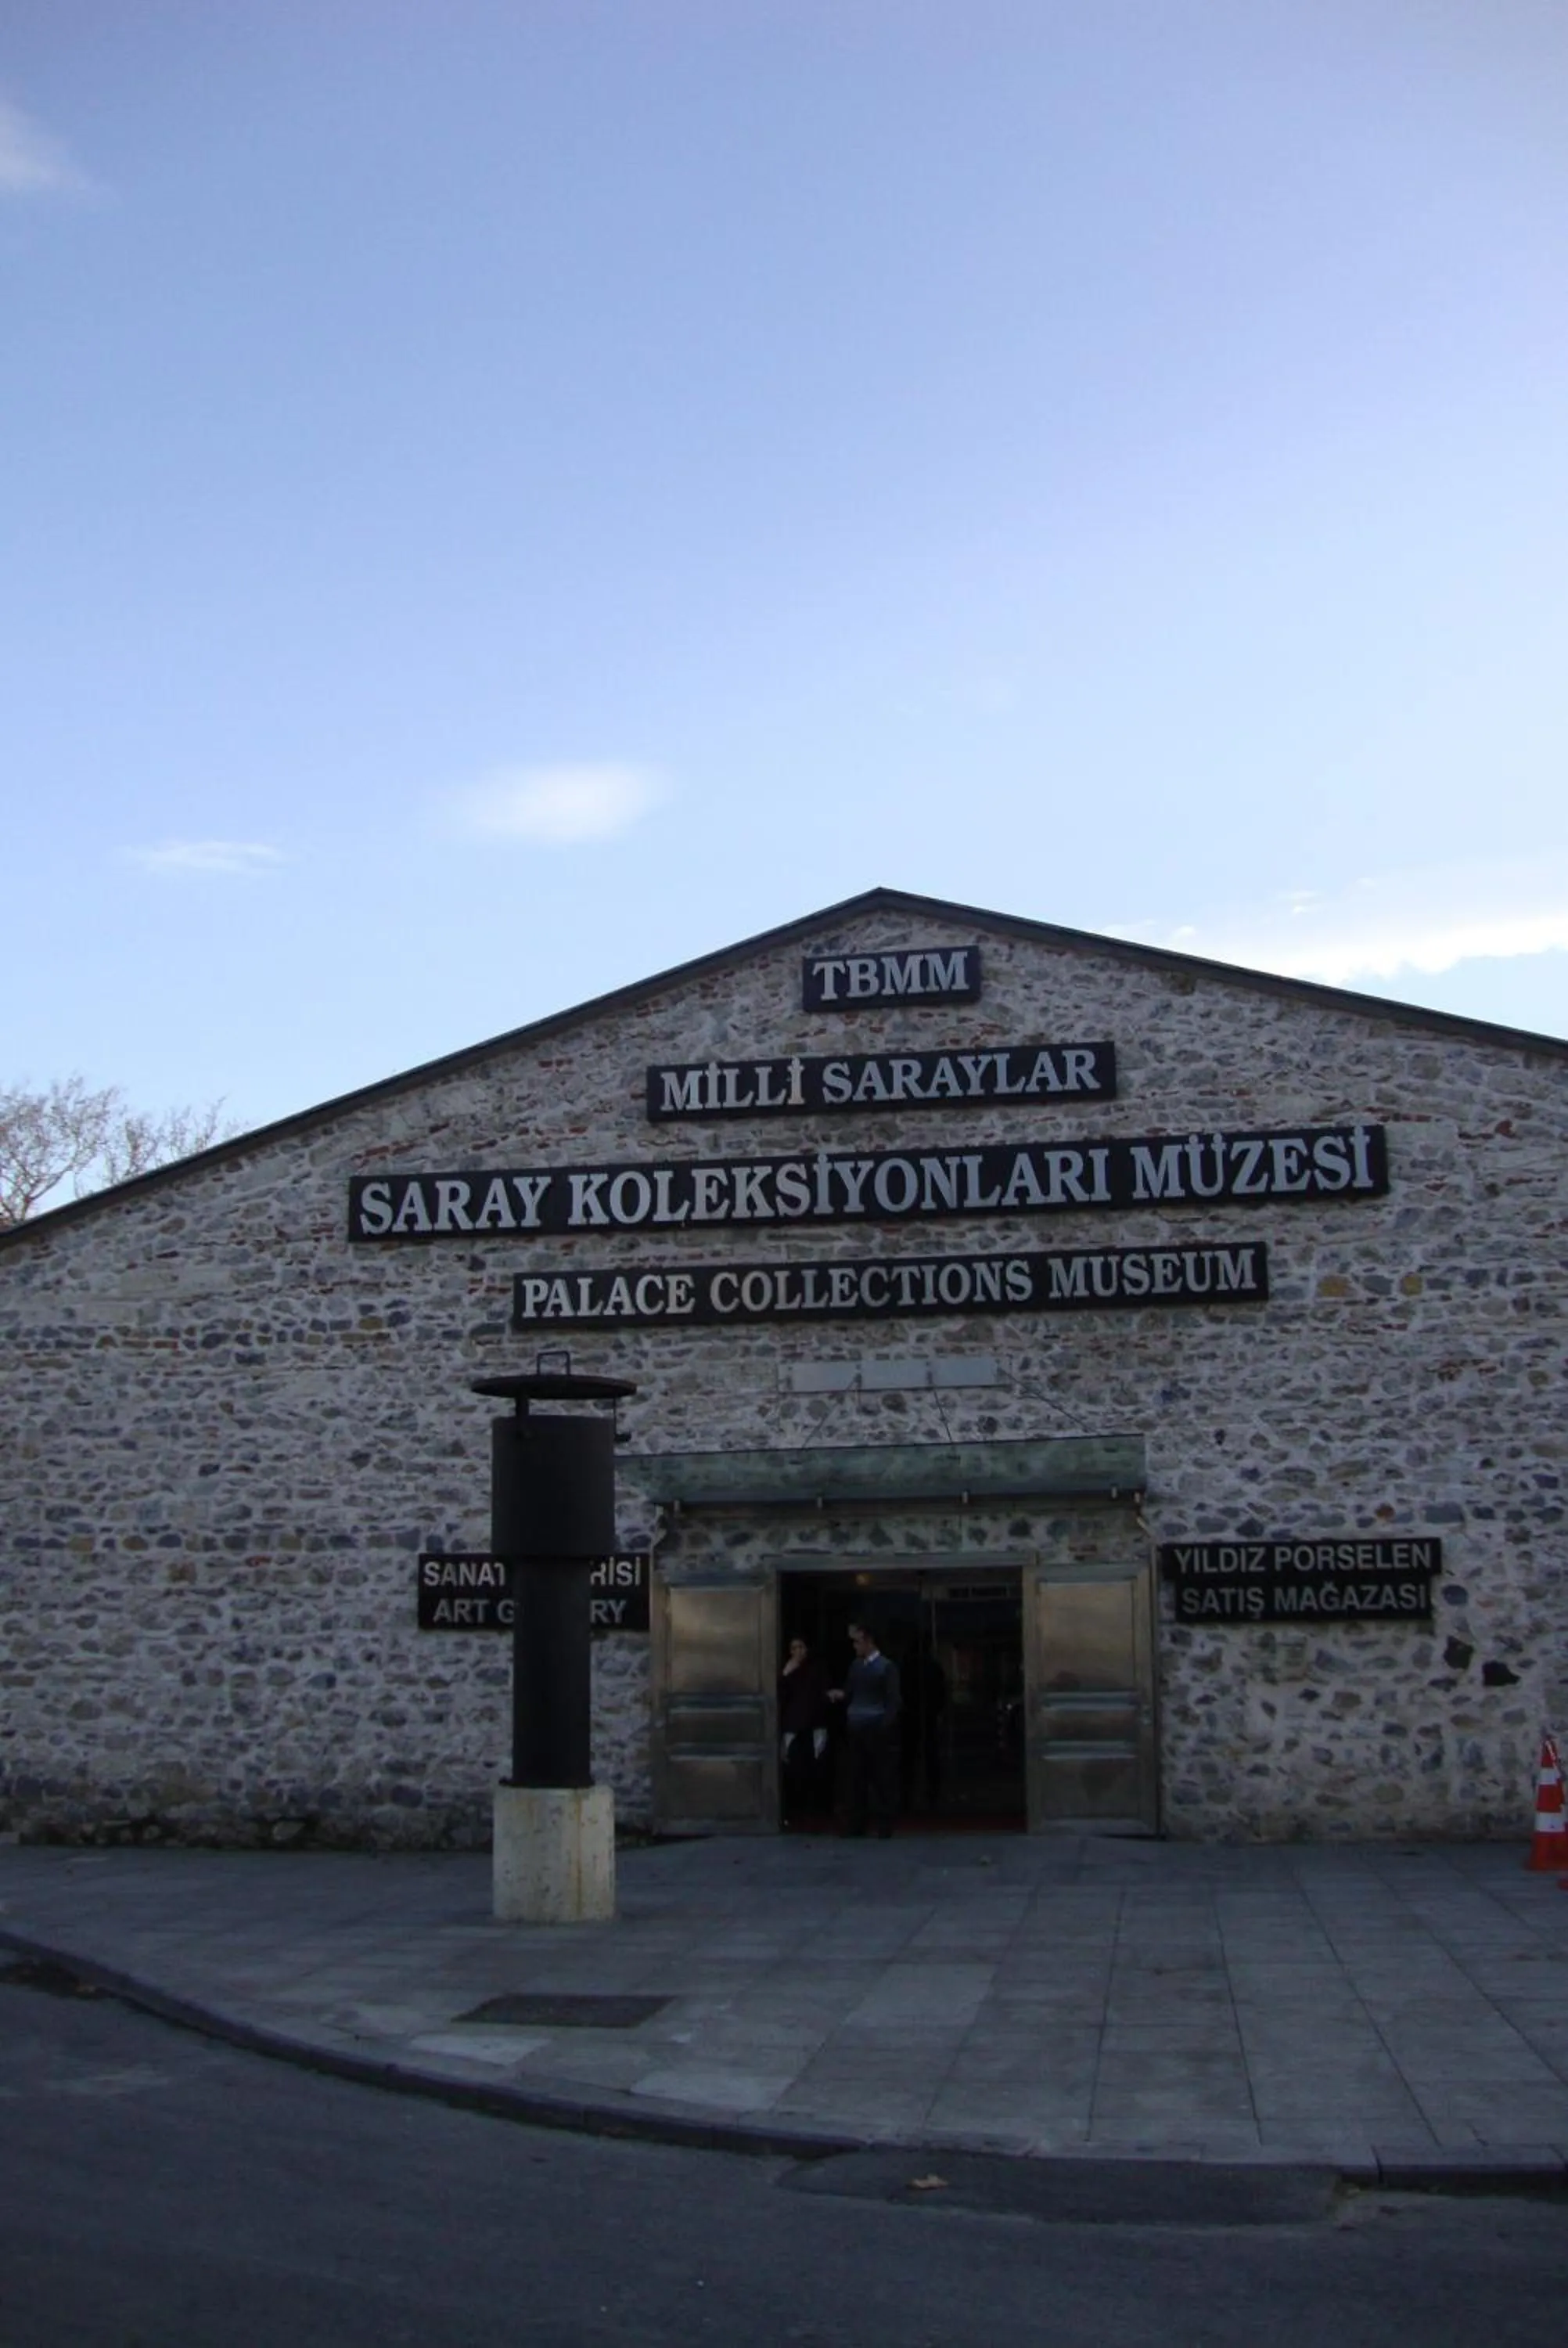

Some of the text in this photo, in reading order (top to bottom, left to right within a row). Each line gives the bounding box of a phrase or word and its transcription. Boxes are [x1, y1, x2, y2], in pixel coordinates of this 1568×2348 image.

[813, 950, 969, 999] TBMM
[660, 1050, 1100, 1111] MİLLİ SARAYLAR
[361, 1126, 1374, 1234] SARAY KOLEKSİYONLARI MÜZESİ
[522, 1249, 1257, 1317] PALACE COLLECTIONS MUSEUM
[1175, 1543, 1430, 1574] YILDIZ PORSELEN
[433, 1599, 489, 1622] ART
[1182, 1580, 1426, 1619] SATIŞ MAĞAZASI
